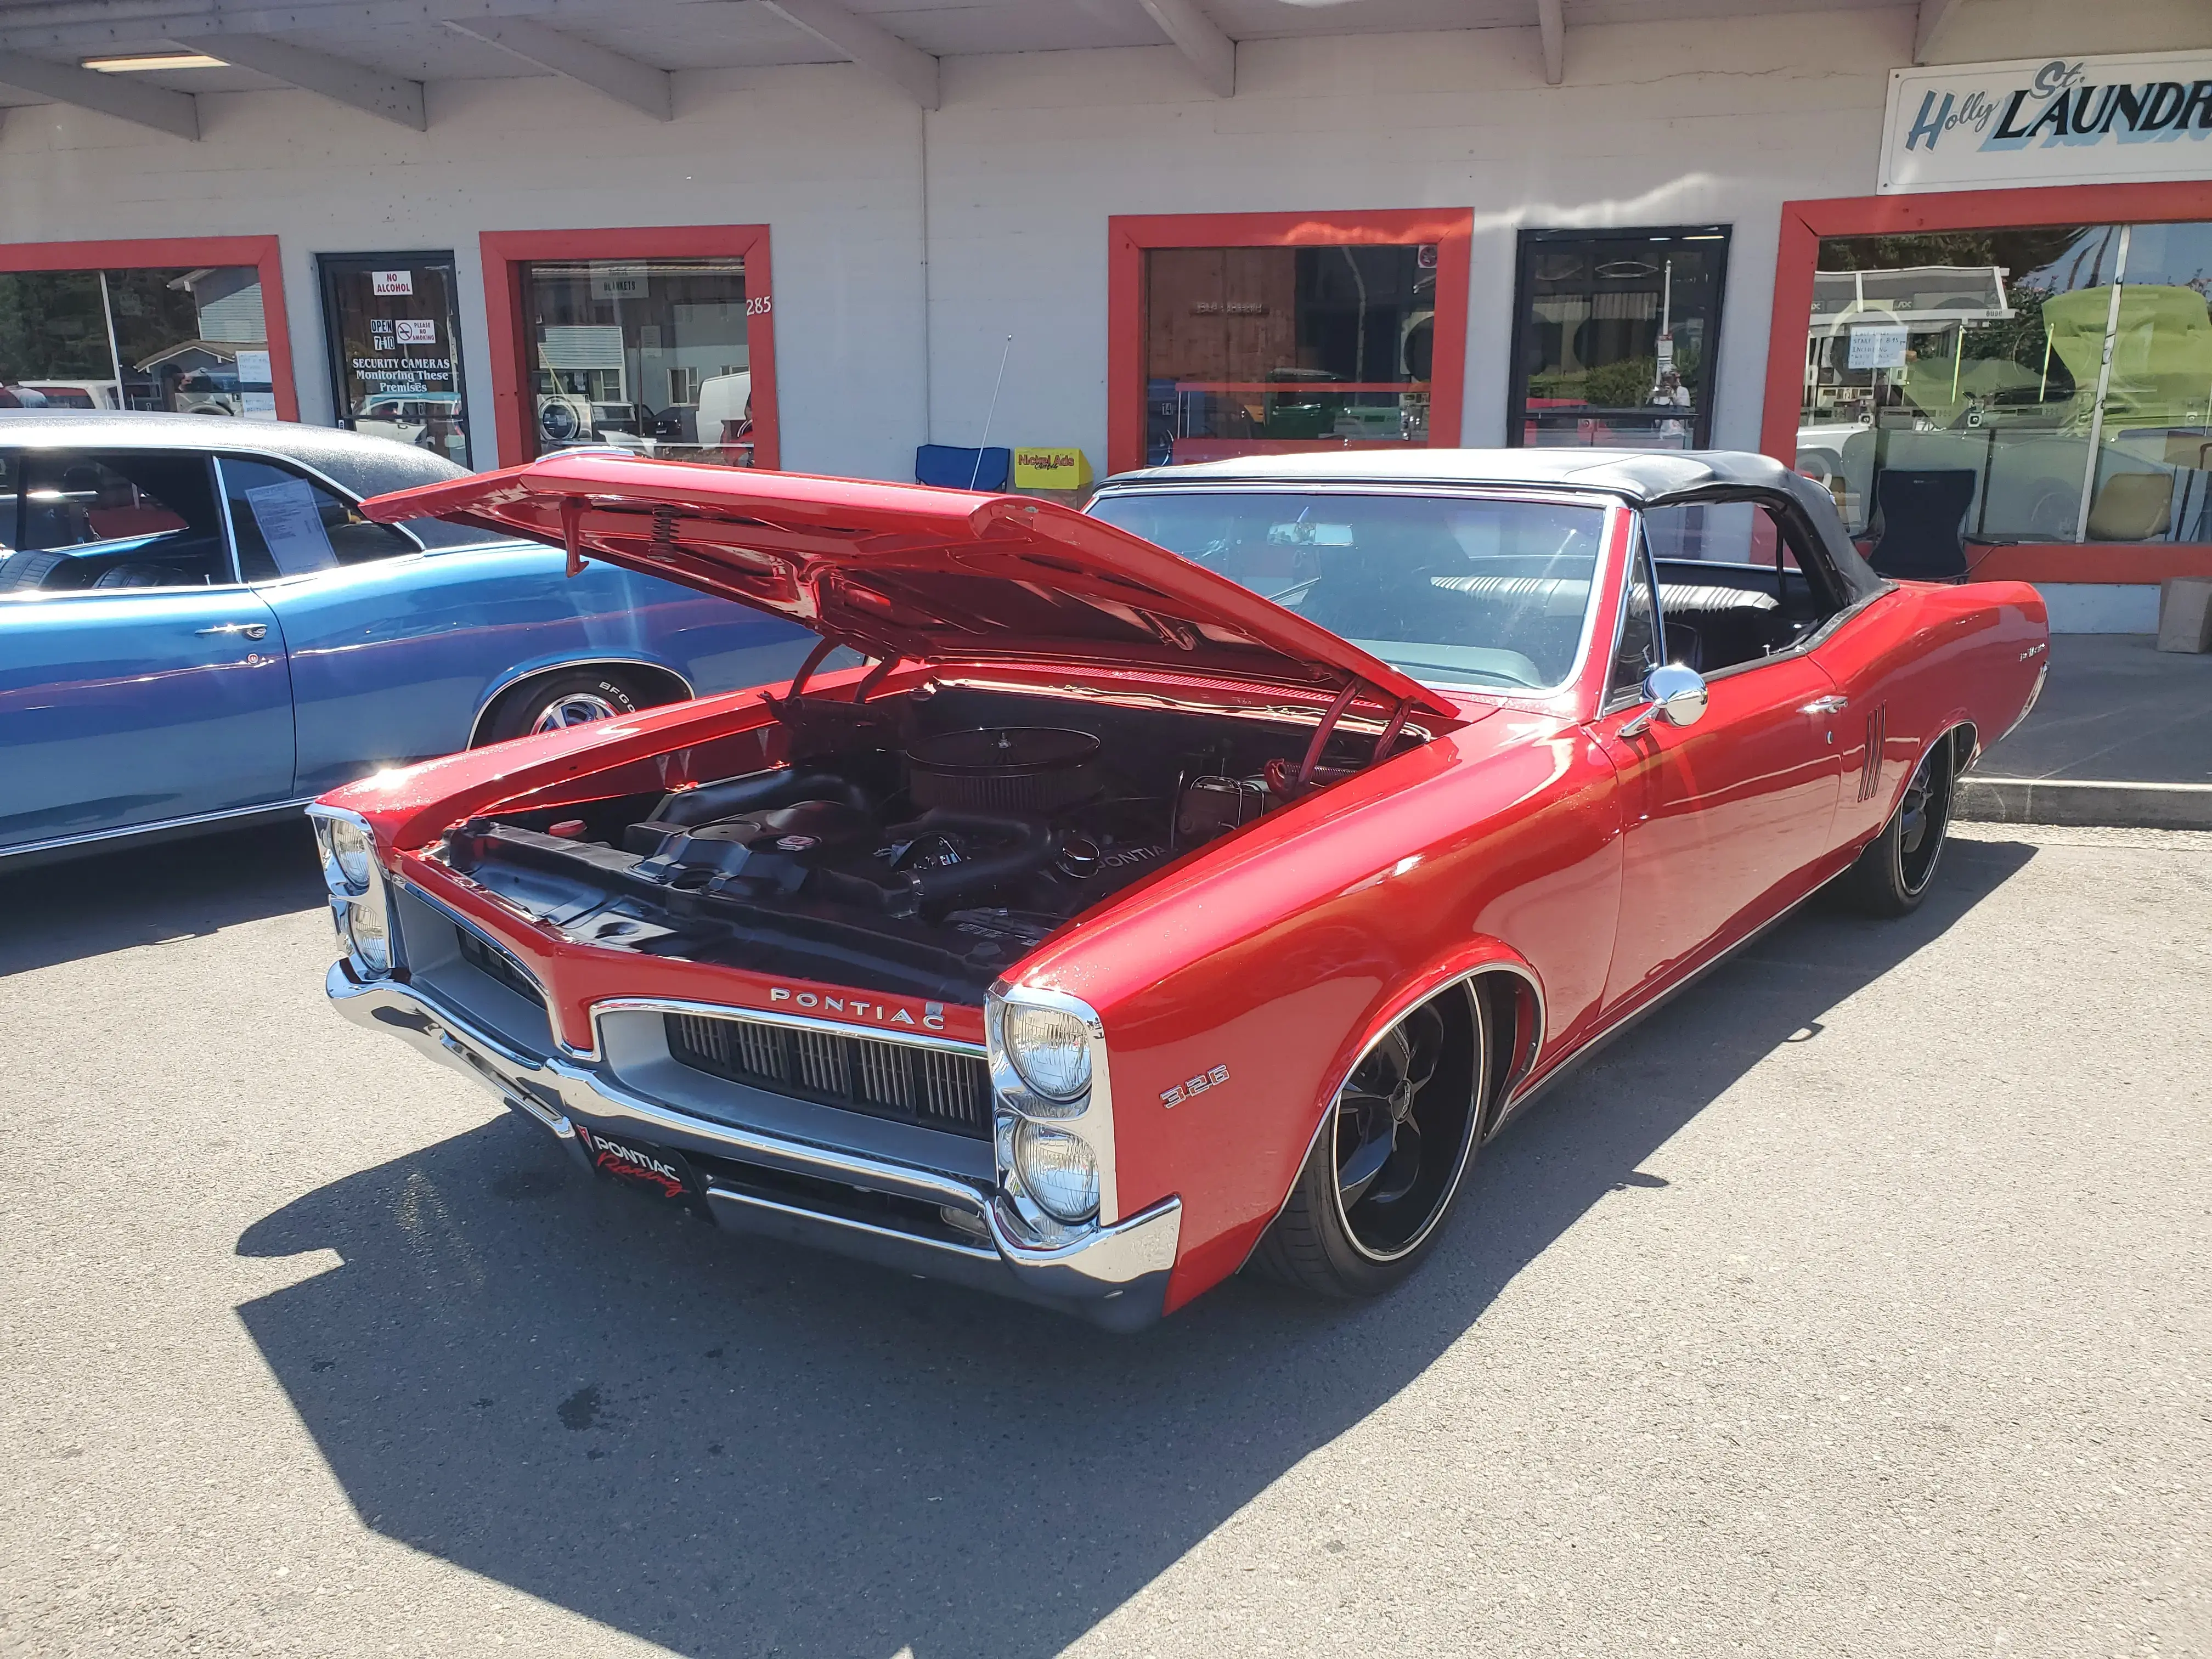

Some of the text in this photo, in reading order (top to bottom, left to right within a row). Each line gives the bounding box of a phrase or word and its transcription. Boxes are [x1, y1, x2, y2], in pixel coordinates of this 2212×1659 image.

[1905, 61, 2085, 151] Holly St.
[1992, 80, 2212, 140] LAUNDR
[386, 273, 398, 281] NO
[377, 283, 410, 292] ALCOHOL
[746, 296, 771, 316] 285
[371, 320, 393, 332] OPEN
[353, 358, 450, 369] SECURITY CAMERAS
[356, 370, 449, 382] Monitoring These
[380, 382, 427, 392] Premises
[1053, 455, 1075, 466] Ads
[770, 987, 944, 1030] PONTIAC
[1160, 1063, 1230, 1109] 326
[592, 1135, 680, 1182] PONTIAC
